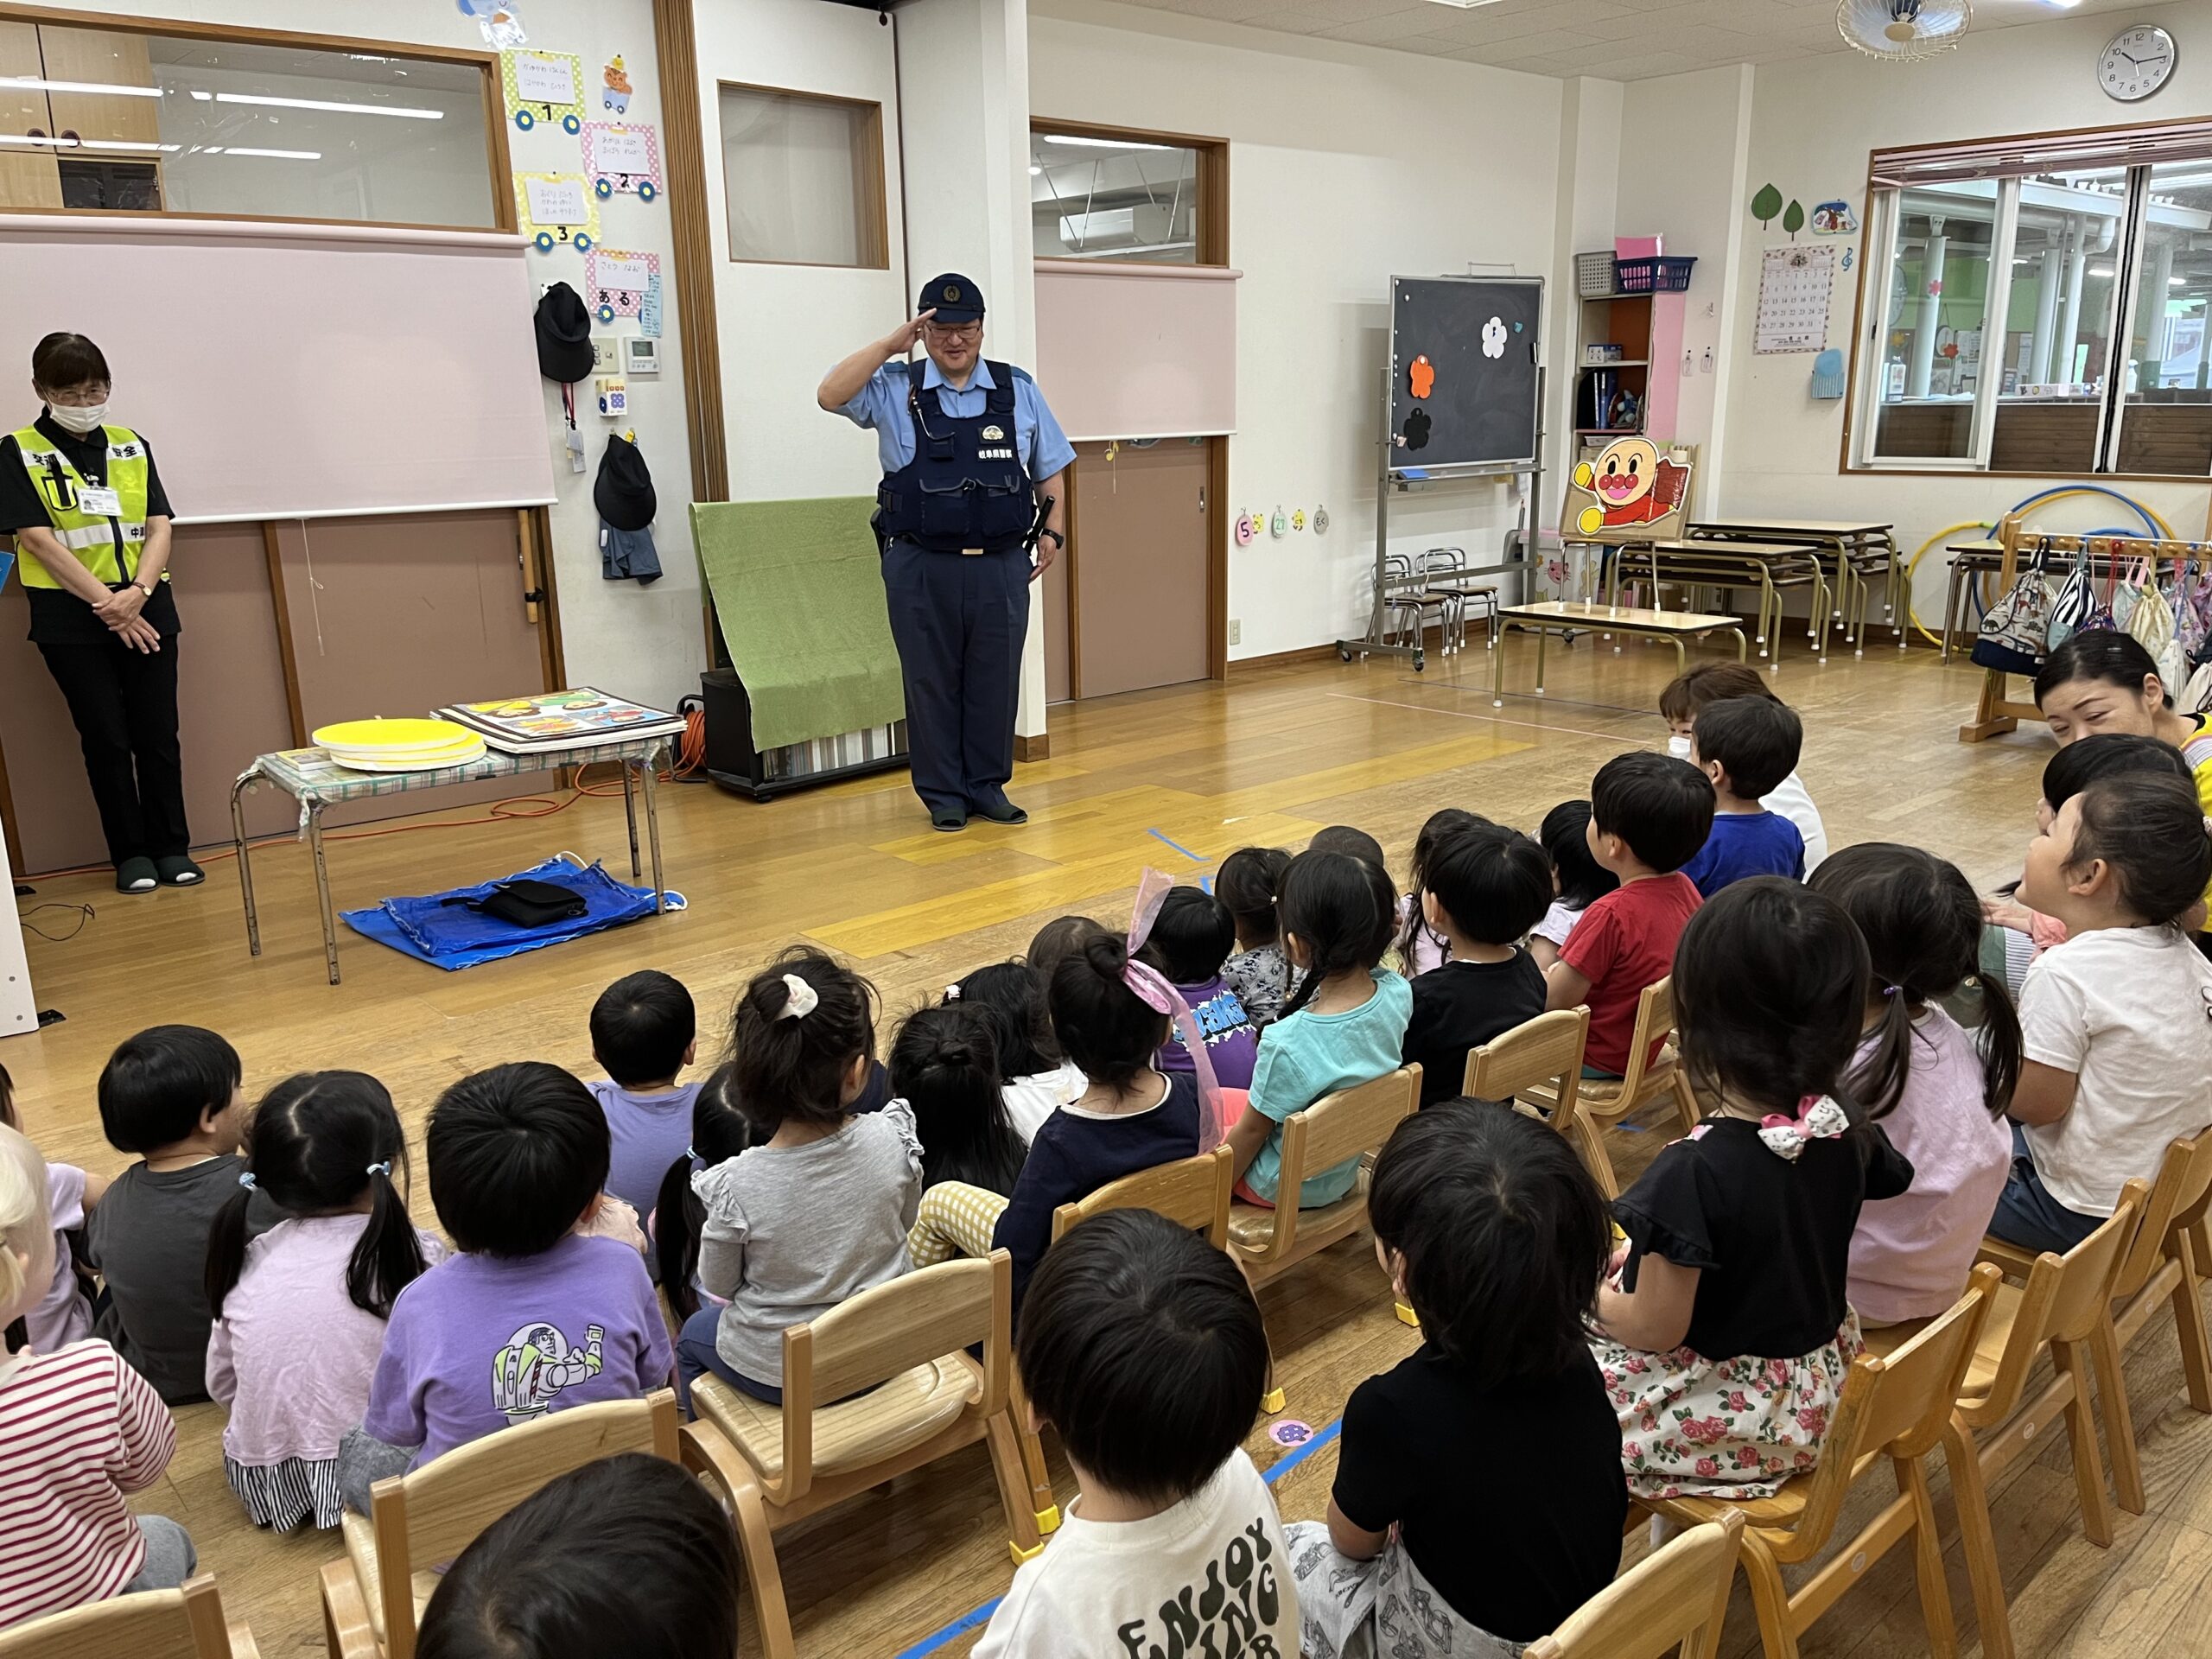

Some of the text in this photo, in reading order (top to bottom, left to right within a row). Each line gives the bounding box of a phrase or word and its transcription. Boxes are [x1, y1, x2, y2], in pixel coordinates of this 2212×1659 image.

[542, 105, 552, 121] 1
[620, 174, 630, 188] 2
[557, 226, 569, 241] 3
[1240, 521, 1249, 537] 5
[1117, 1516, 1273, 1659] ENJOY
